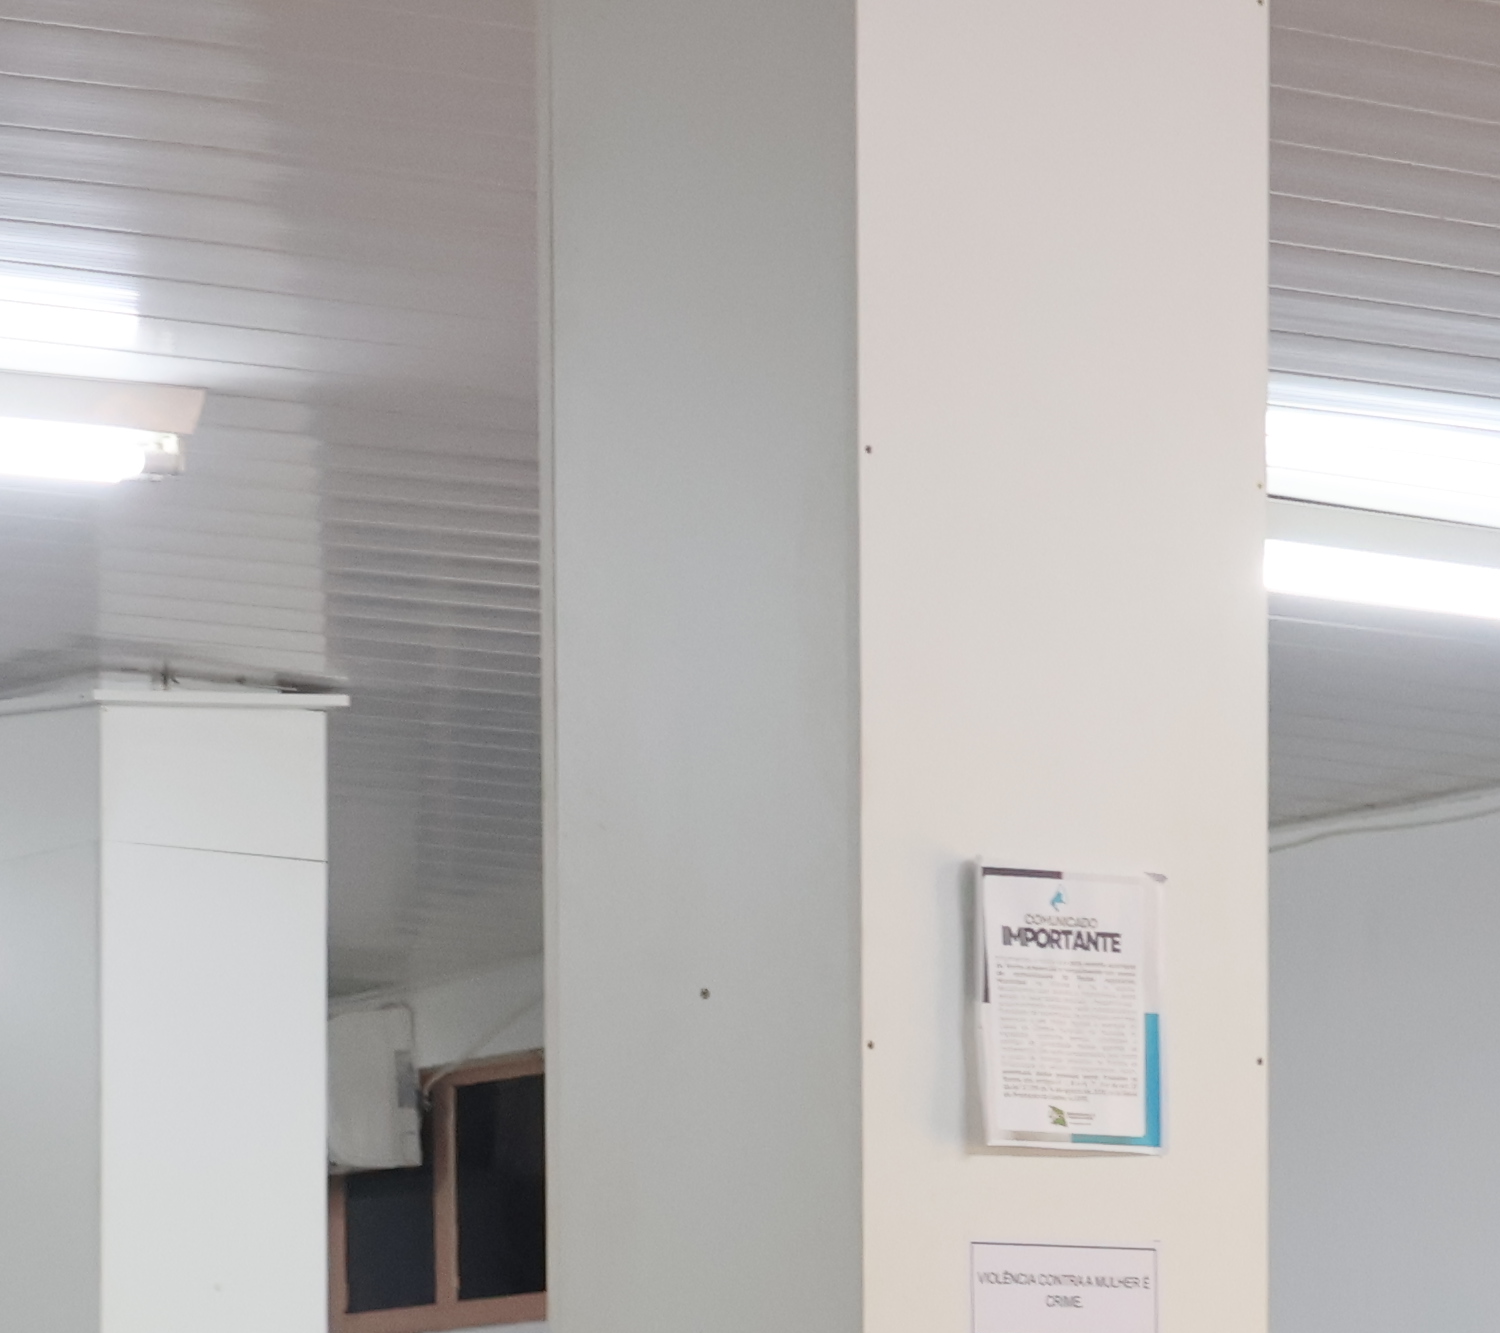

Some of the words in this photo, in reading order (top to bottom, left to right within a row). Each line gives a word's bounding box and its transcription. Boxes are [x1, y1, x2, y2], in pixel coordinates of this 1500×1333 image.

[1002, 925, 1122, 953] IMPORTANTE
[977, 1270, 1037, 1285] VIOLÊNCIA
[1039, 1274, 1084, 1287] CONTRA
[1095, 1276, 1143, 1290] MULHER
